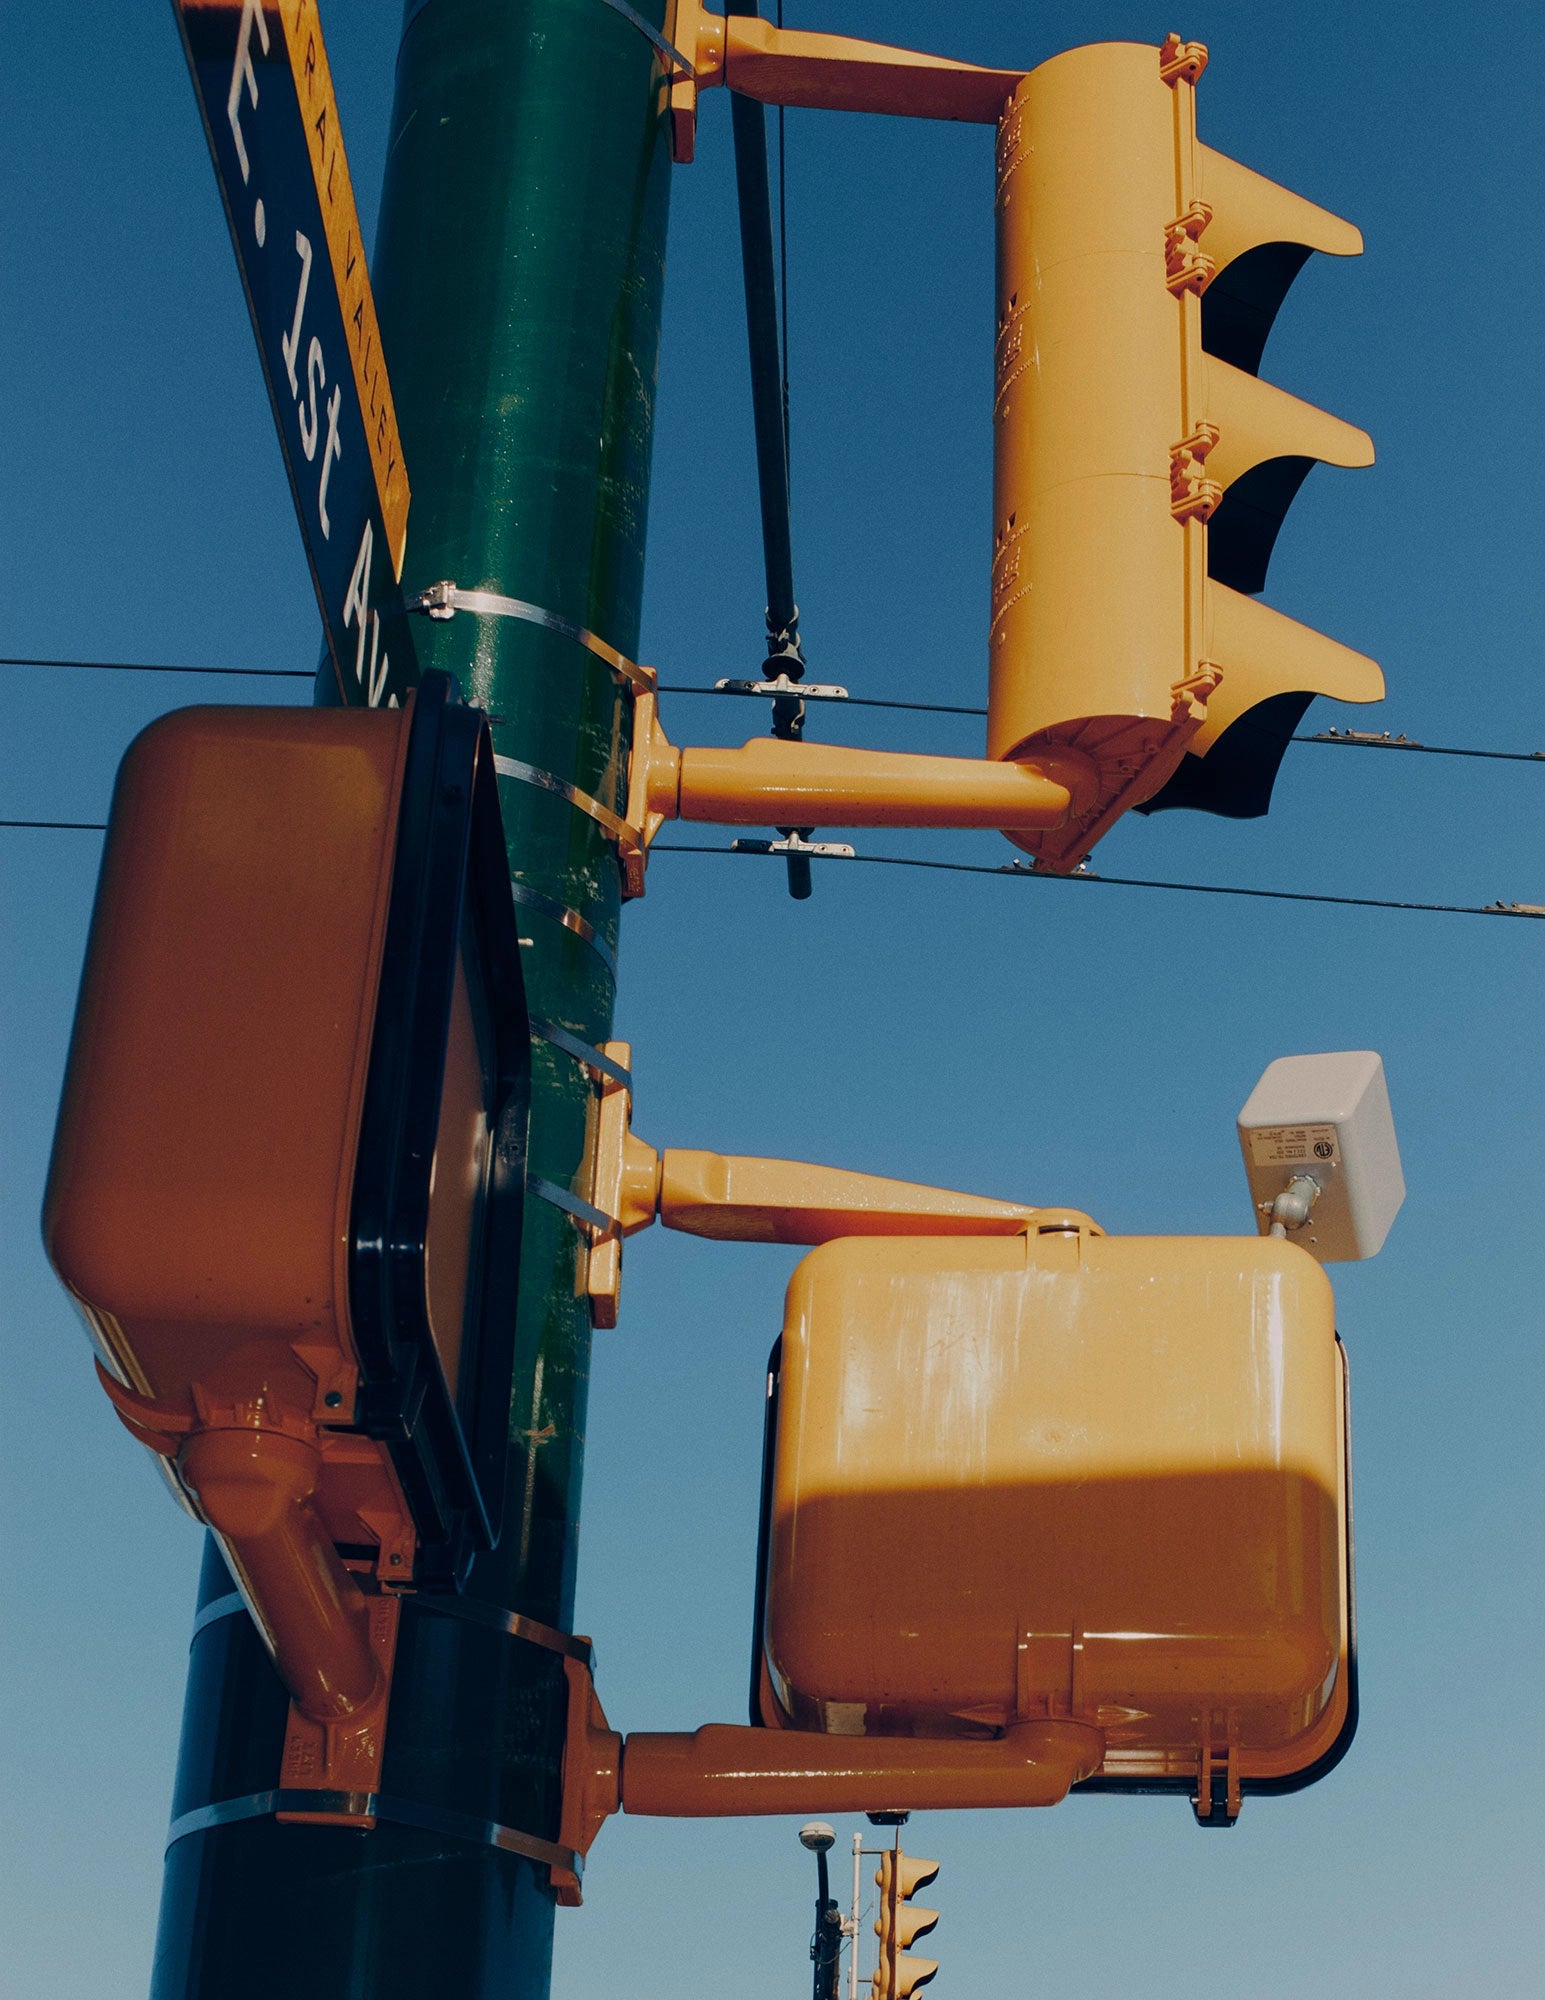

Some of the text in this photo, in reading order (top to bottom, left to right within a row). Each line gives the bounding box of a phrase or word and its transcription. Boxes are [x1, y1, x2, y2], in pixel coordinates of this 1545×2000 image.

[282, 230, 341, 540] 1st
[343, 519, 399, 709] Av
[346, 230, 394, 486] VALLEY
